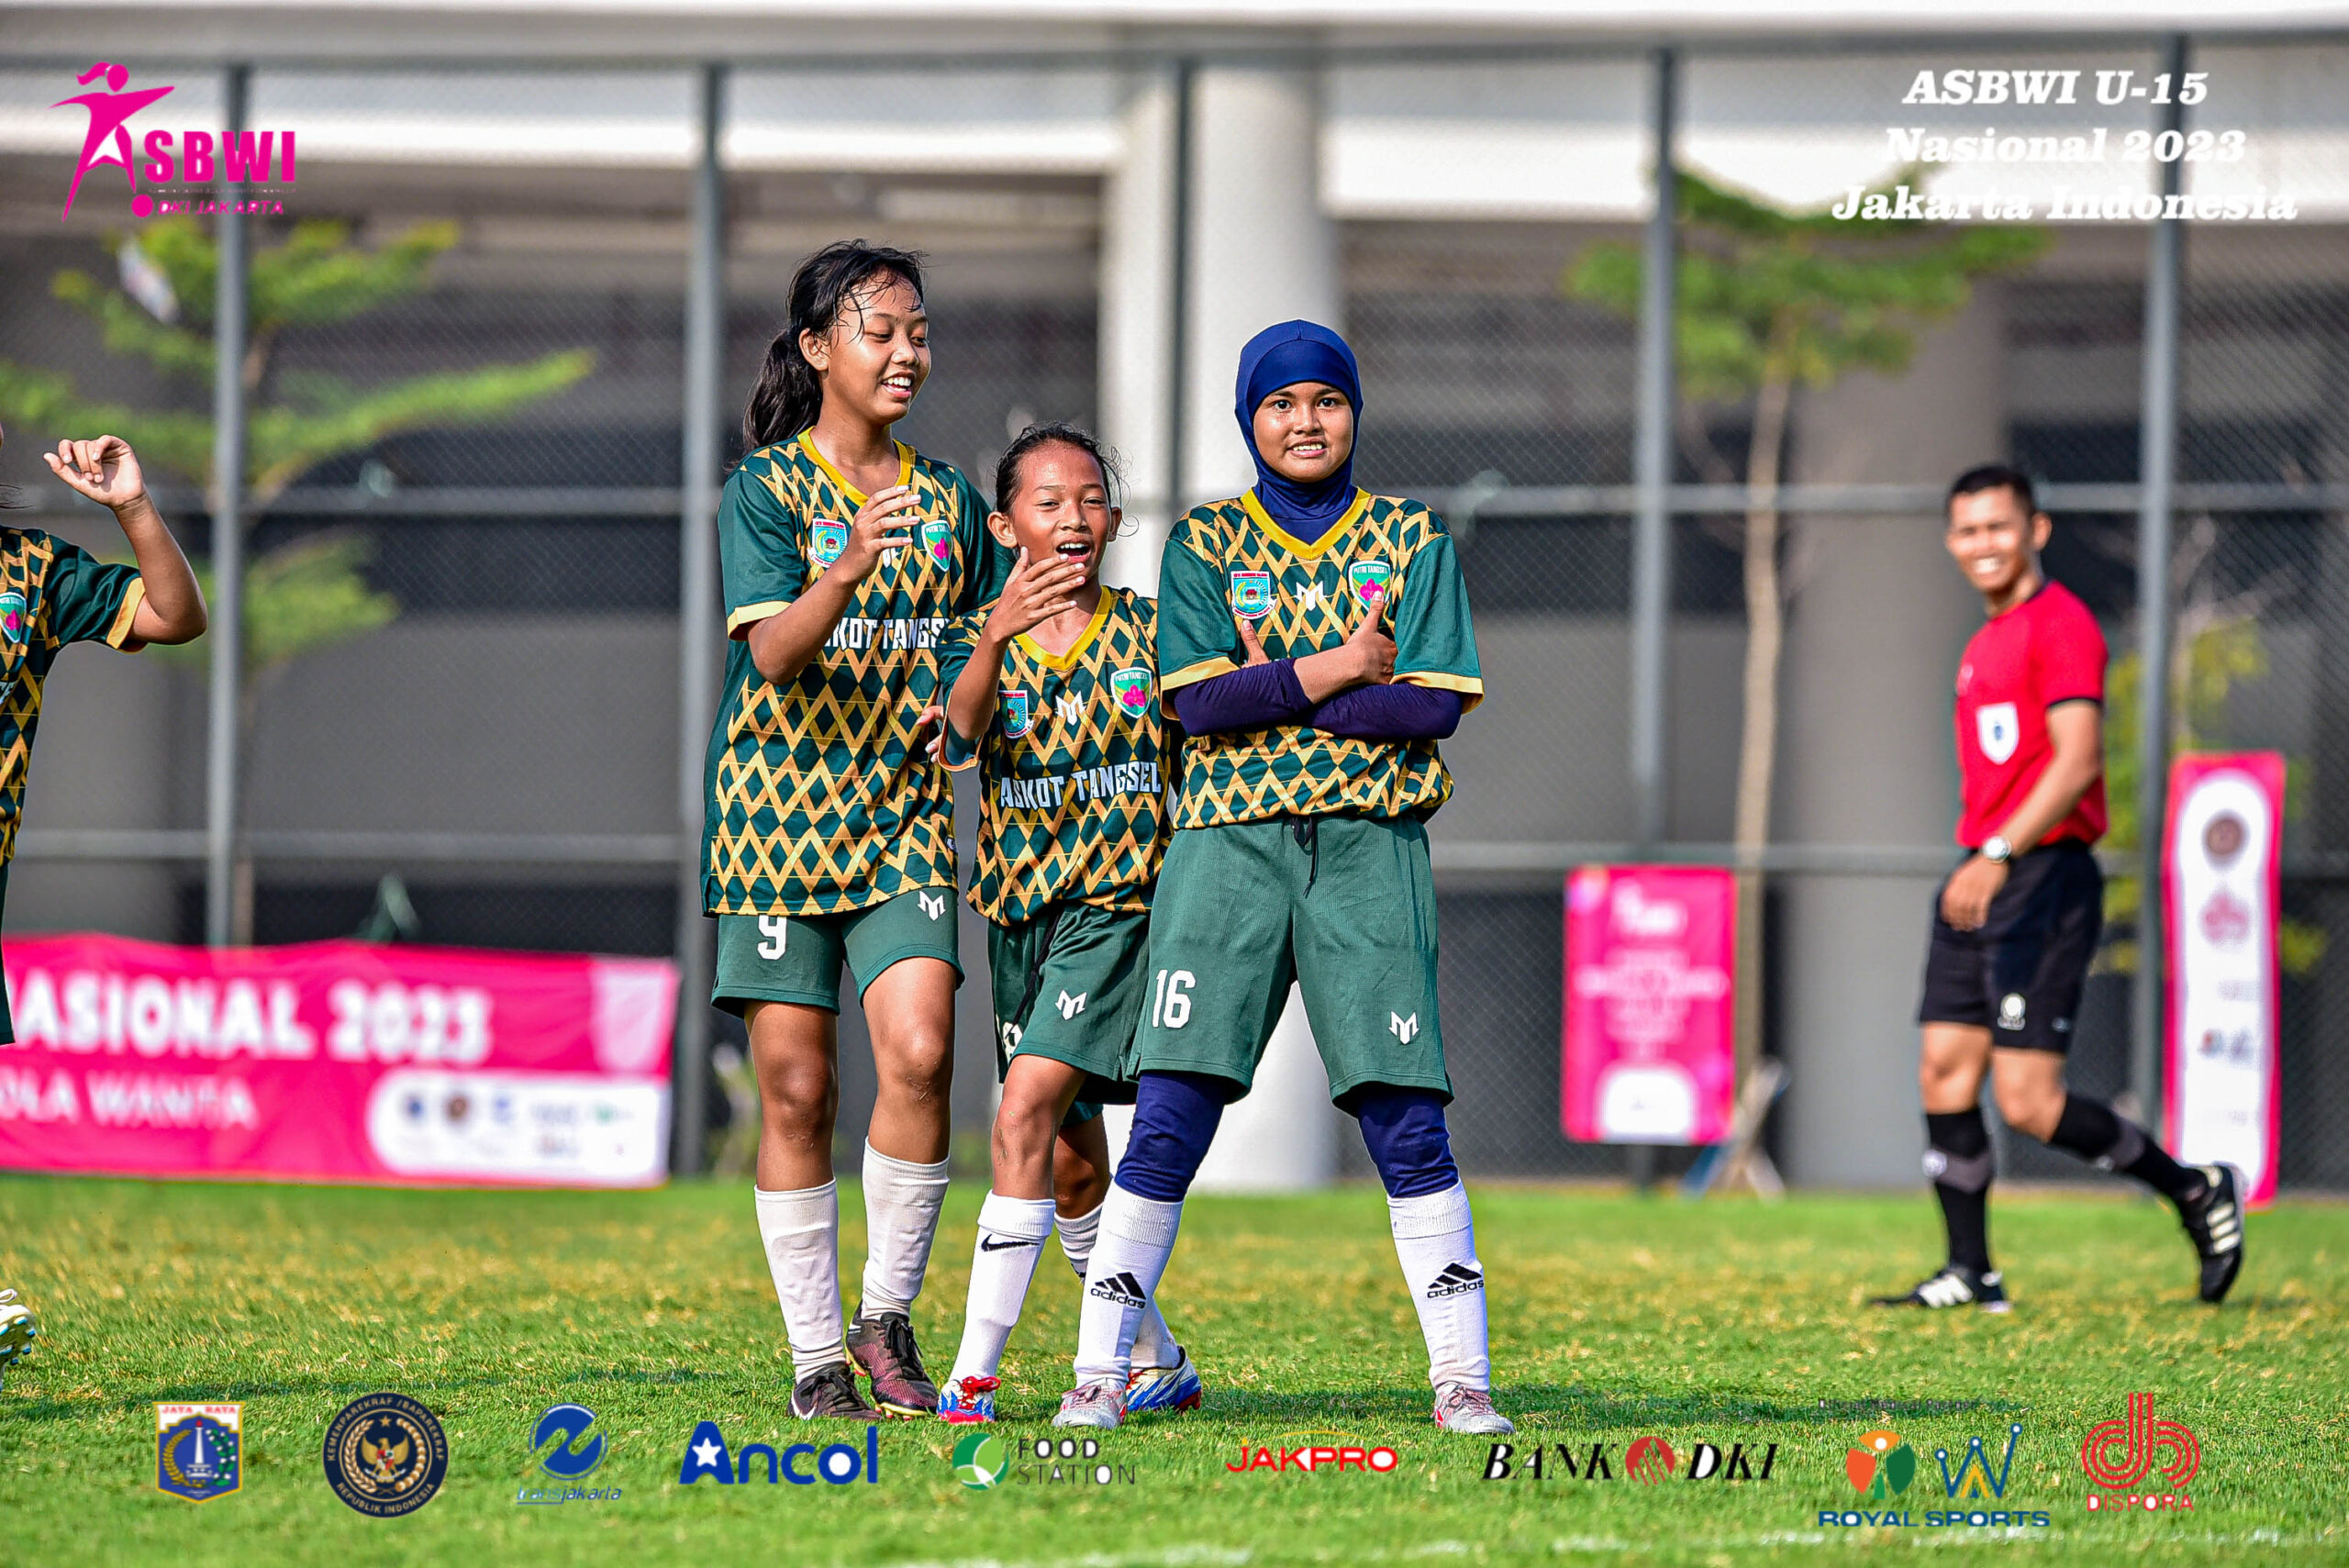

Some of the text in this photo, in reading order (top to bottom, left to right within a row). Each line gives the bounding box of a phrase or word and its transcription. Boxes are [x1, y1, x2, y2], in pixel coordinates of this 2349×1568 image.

[824, 617, 878, 651] KOT
[1000, 762, 1162, 810] ASKOT TANGSEL
[757, 915, 786, 961] 9
[4, 968, 494, 1066] ASIONAL 2023
[1152, 970, 1196, 1029] 16
[1090, 1287, 1147, 1309] adidas
[1427, 1279, 1485, 1298] adidas
